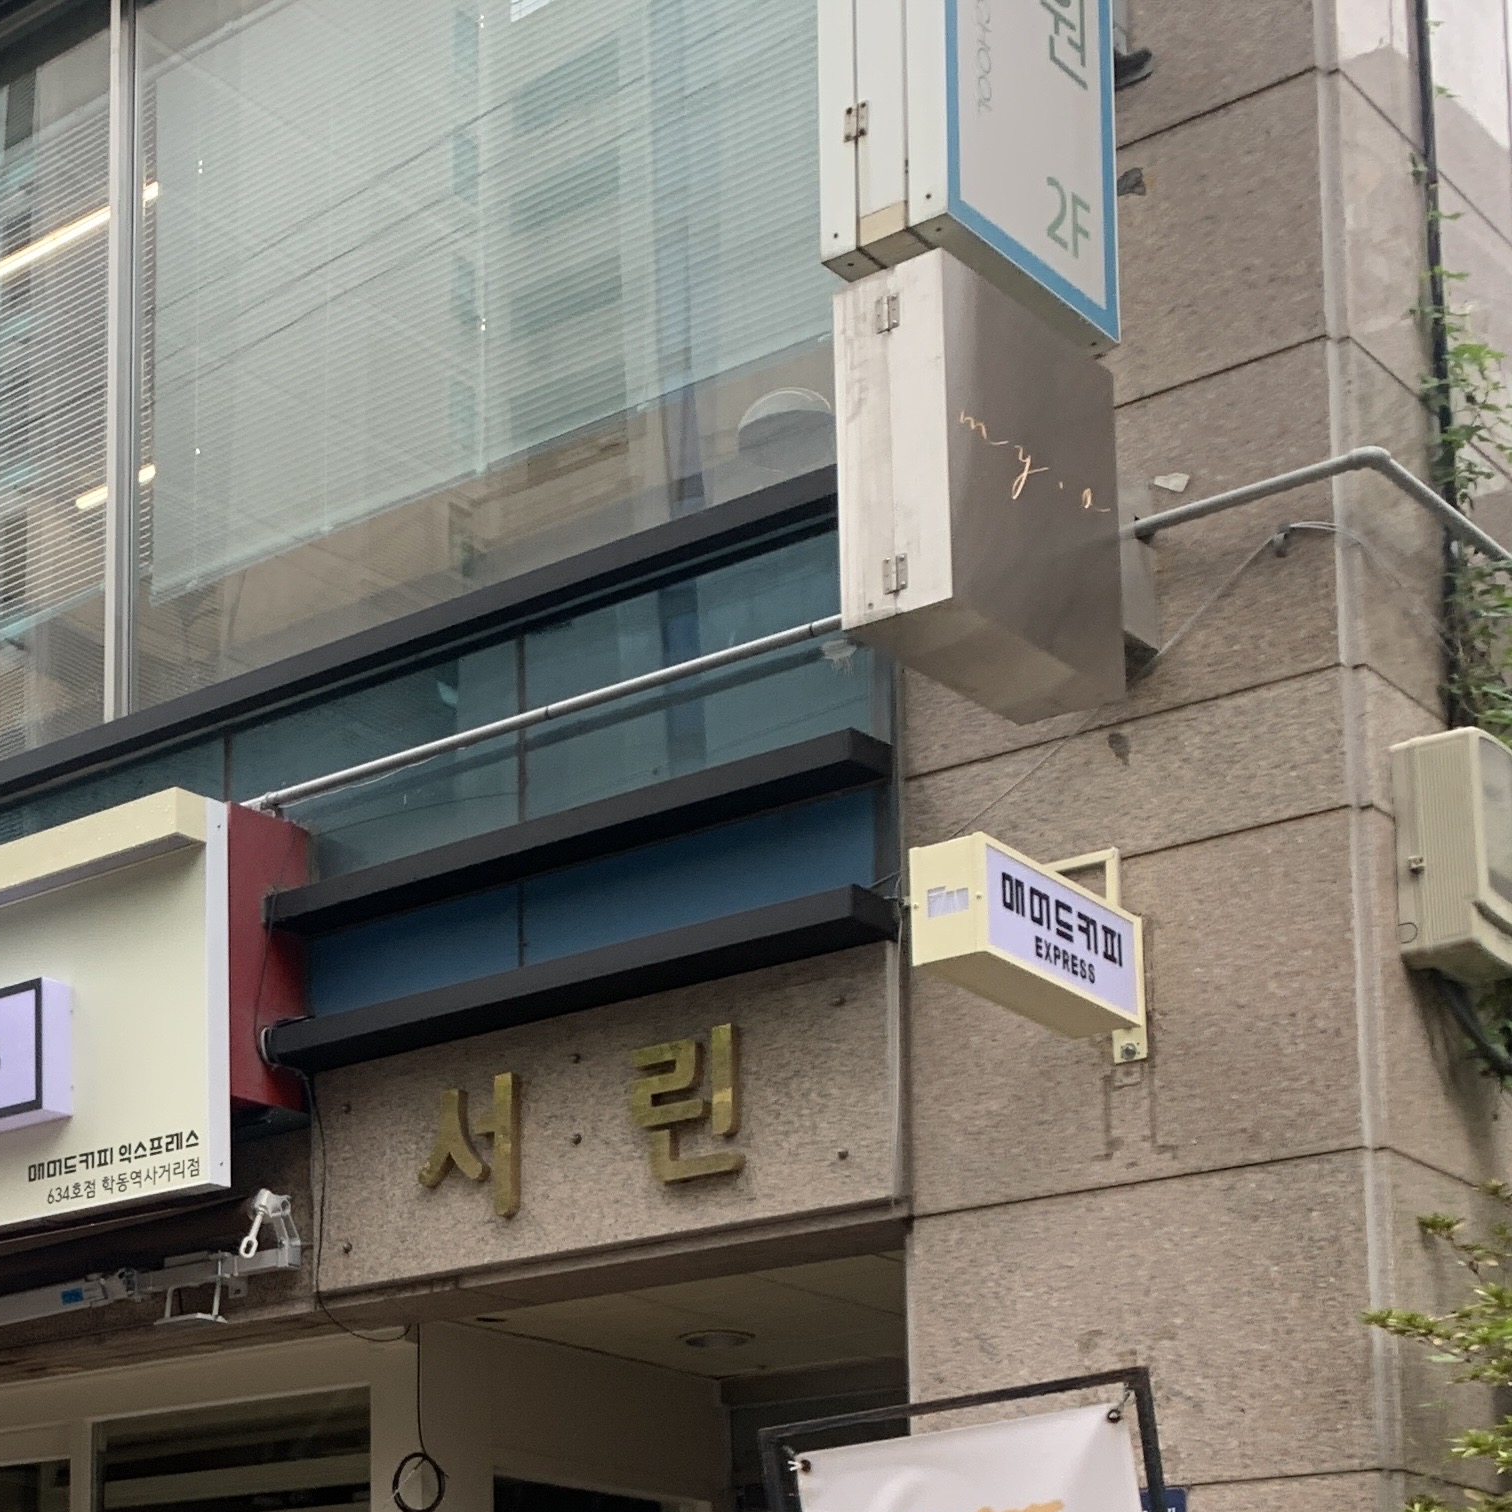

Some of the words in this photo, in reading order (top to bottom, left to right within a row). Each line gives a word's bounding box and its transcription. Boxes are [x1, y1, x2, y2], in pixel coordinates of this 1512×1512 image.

[1045, 176, 1091, 259] 2F
[1034, 935, 1096, 985] EXPRESS
[118, 1130, 200, 1163] 익스프레스
[46, 1179, 97, 1205] 634호점
[101, 1156, 201, 1194] 학동역사거리점
